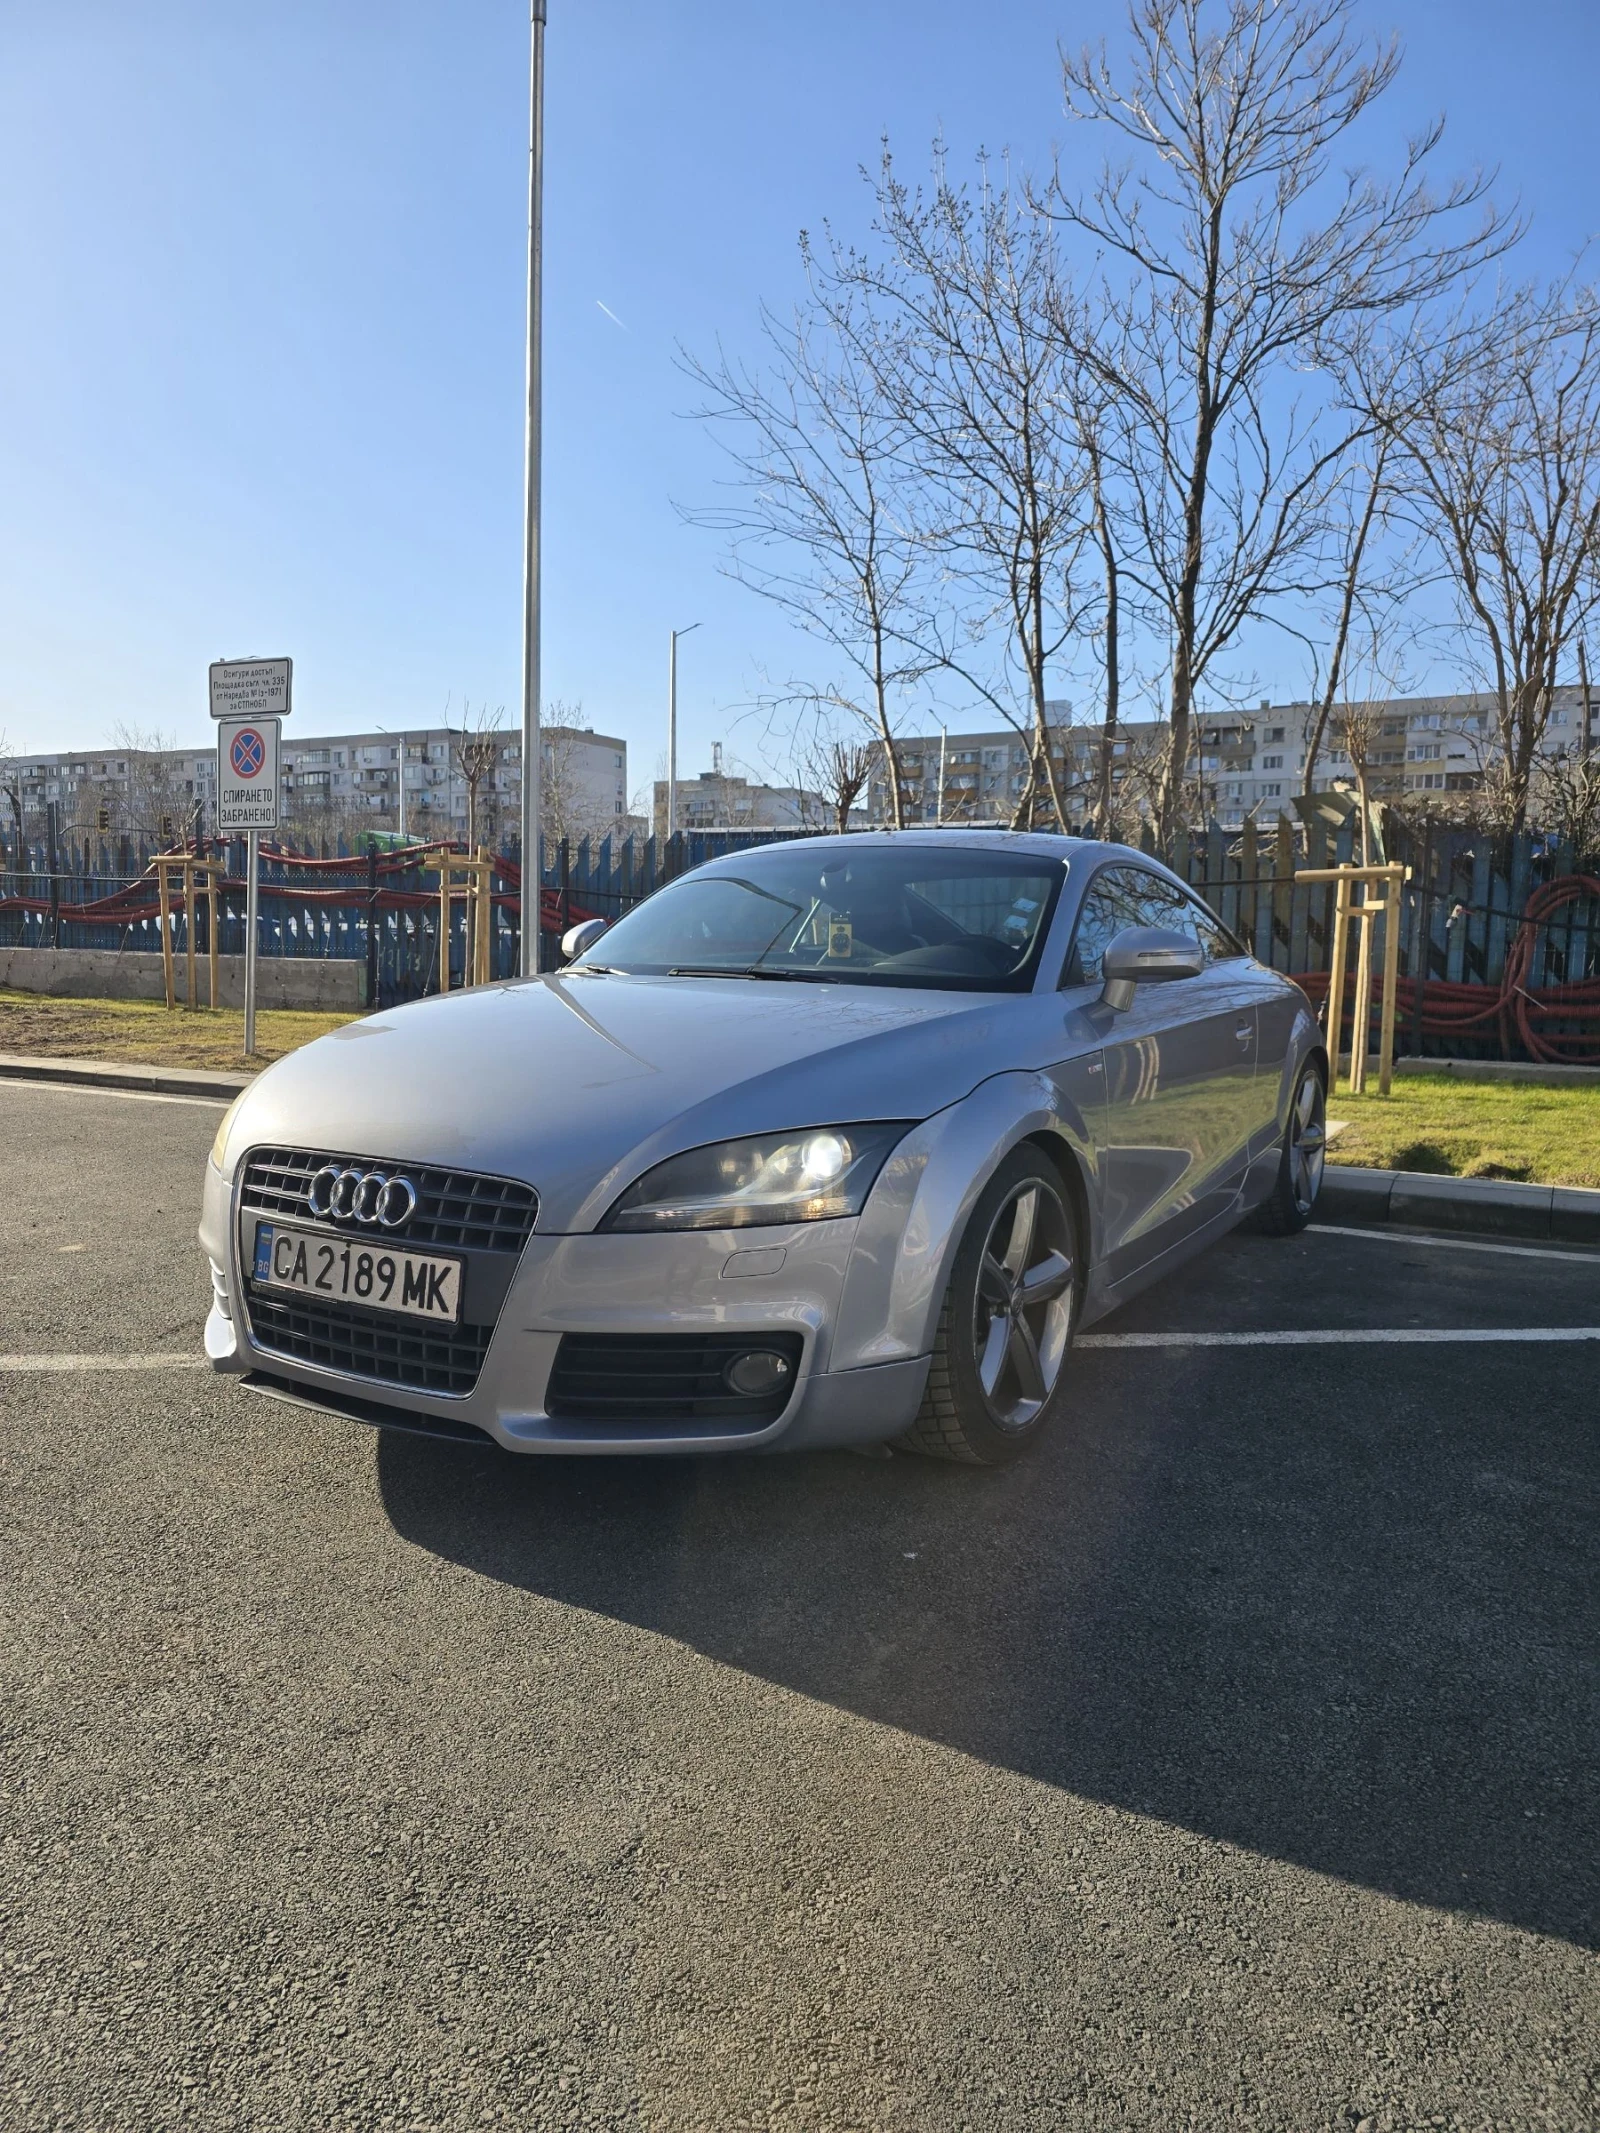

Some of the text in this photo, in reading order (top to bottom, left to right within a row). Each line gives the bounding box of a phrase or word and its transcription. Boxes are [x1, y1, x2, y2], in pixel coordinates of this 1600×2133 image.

[224, 670, 249, 679] Осигури
[214, 681, 244, 690] Площадка
[272, 676, 285, 686] 335
[224, 690, 249, 700] Наредба
[224, 788, 272, 804] СПИРАНЕТО
[222, 808, 274, 822] ЗАБРАНЕНО!
[257, 1259, 270, 1274] BG
[315, 1245, 396, 1302] 2189
